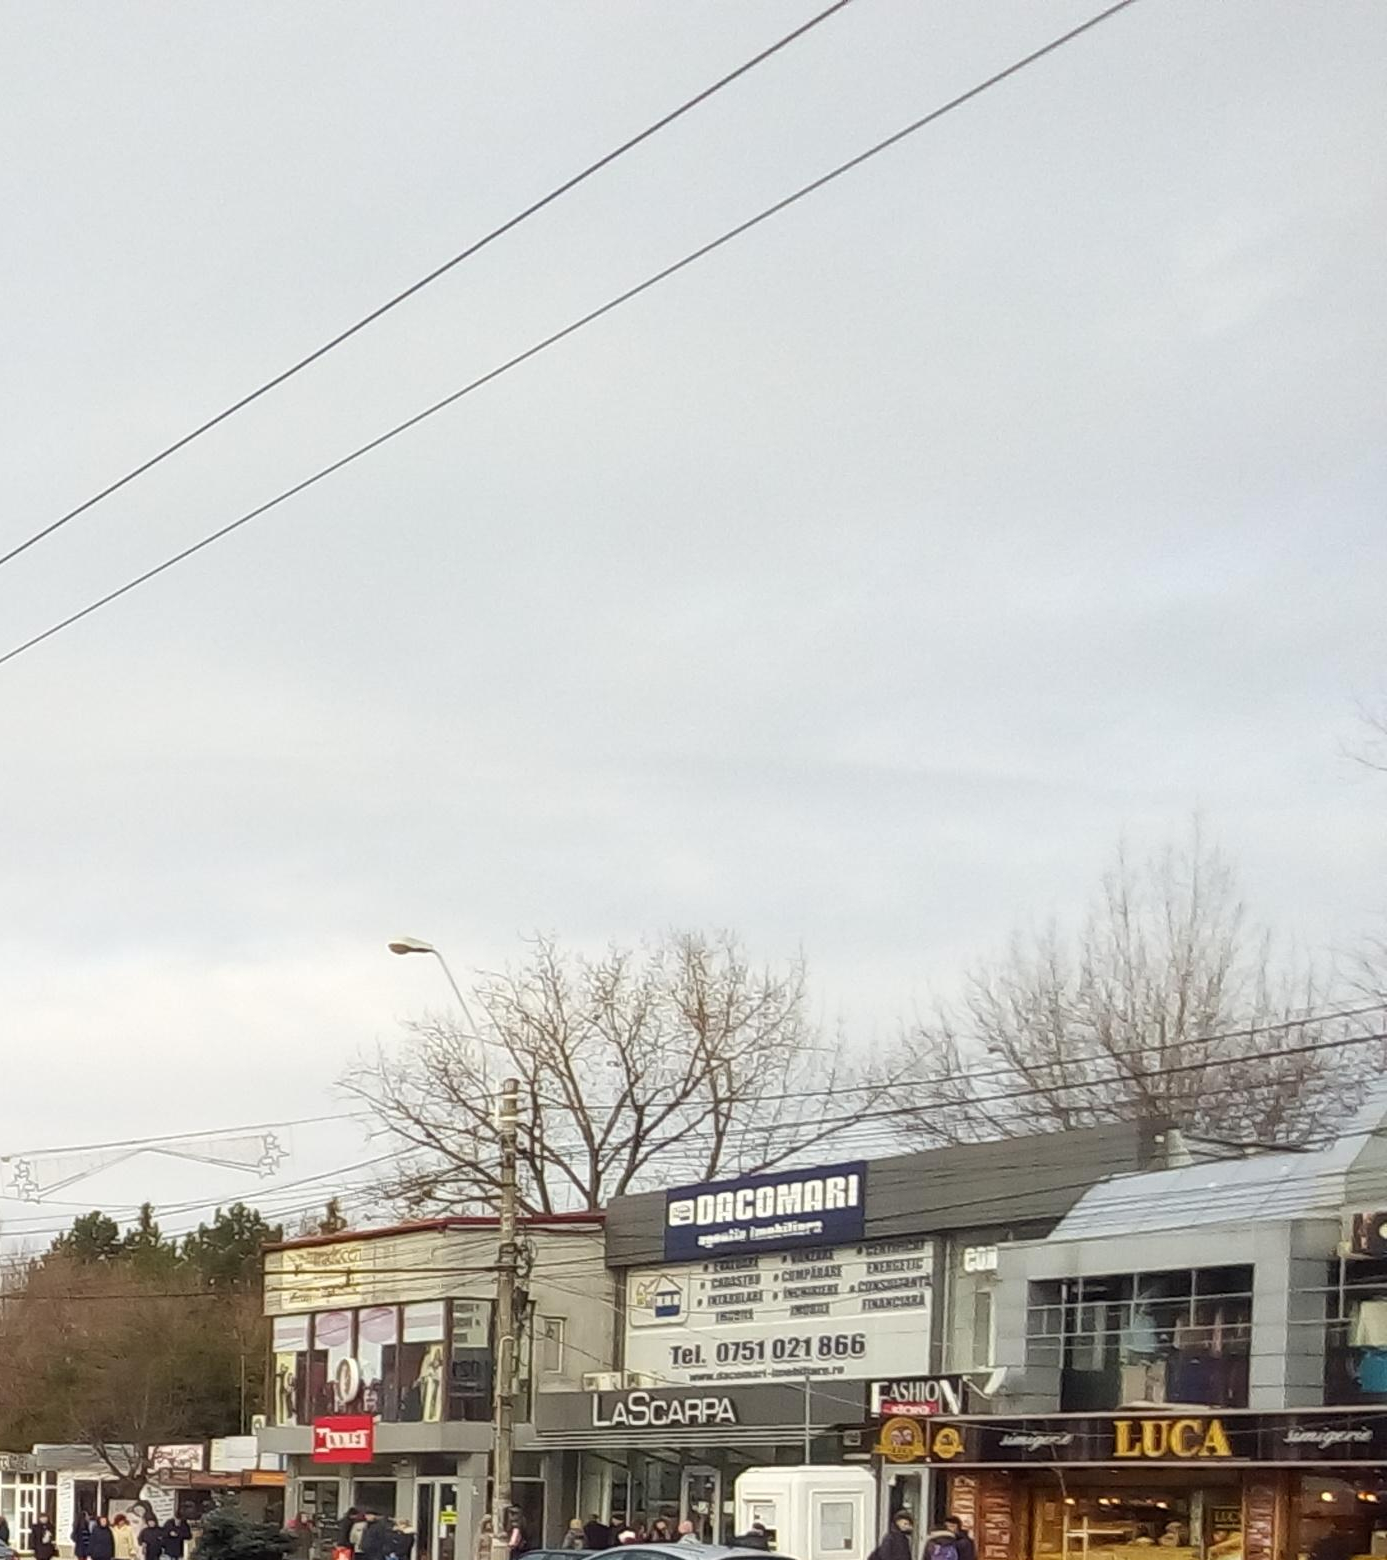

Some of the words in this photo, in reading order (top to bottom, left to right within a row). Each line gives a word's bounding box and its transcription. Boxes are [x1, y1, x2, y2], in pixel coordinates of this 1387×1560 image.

[696, 1174, 859, 1225] DACOMARI
[670, 1345, 705, 1365] Tel.
[716, 1341, 765, 1362] 0751
[772, 1337, 812, 1360] 021
[818, 1333, 866, 1356] 866
[871, 1379, 961, 1416] FASHION
[1113, 1419, 1232, 1457] LUCA
